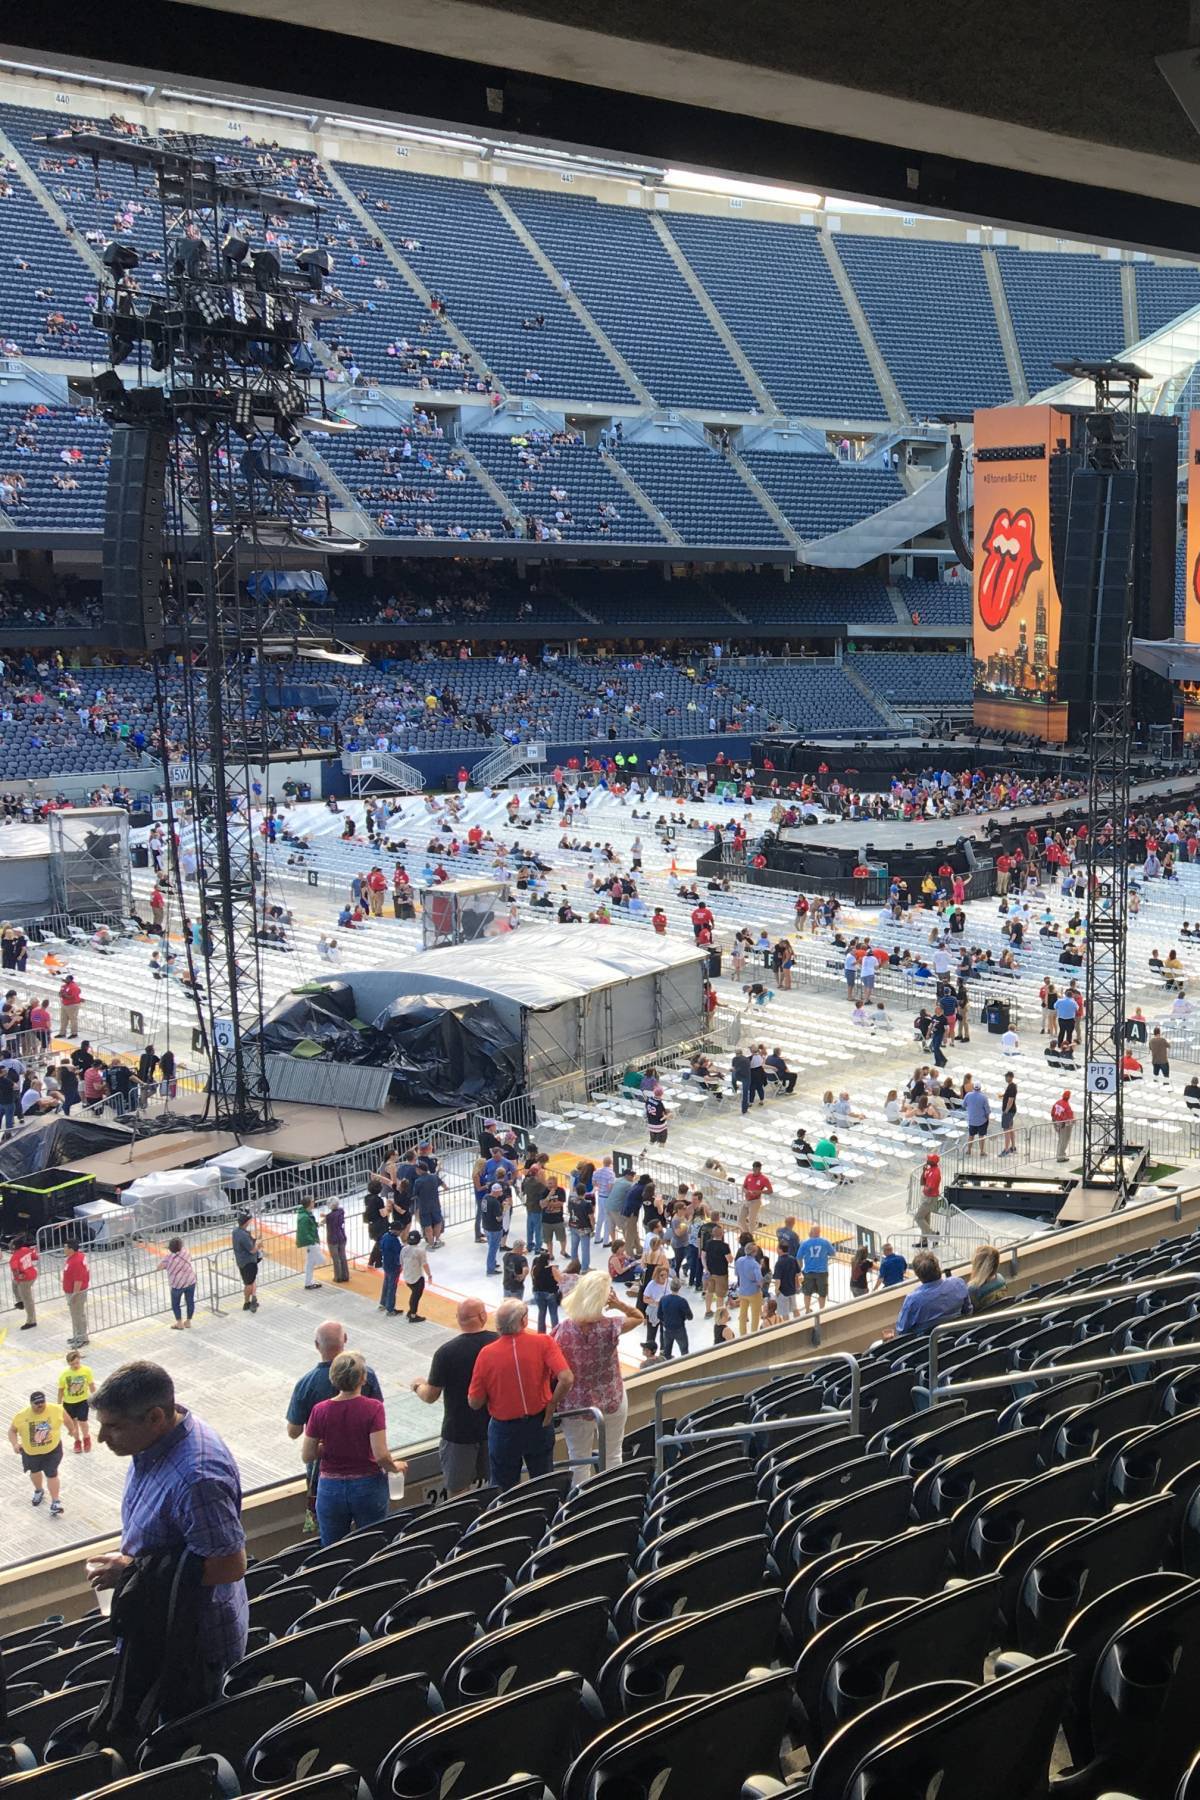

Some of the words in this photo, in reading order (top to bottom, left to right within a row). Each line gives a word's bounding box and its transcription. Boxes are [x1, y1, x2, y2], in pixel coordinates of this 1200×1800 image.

[55, 93, 71, 105] 440
[227, 121, 243, 132] 441
[396, 146, 409, 157] 442
[561, 173, 575, 184] 443
[174, 768, 190, 781] 5W
[133, 1014, 141, 1033] K
[214, 1022, 226, 1032] PIT
[1130, 1023, 1140, 1039] A
[195, 1030, 202, 1049] J
[1090, 1066, 1105, 1075] PIT
[1108, 1067, 1114, 1075] 2
[518, 1133, 526, 1150] J
[618, 1156, 628, 1175] H
[861, 1231, 872, 1255] H
[809, 1245, 822, 1258] 17
